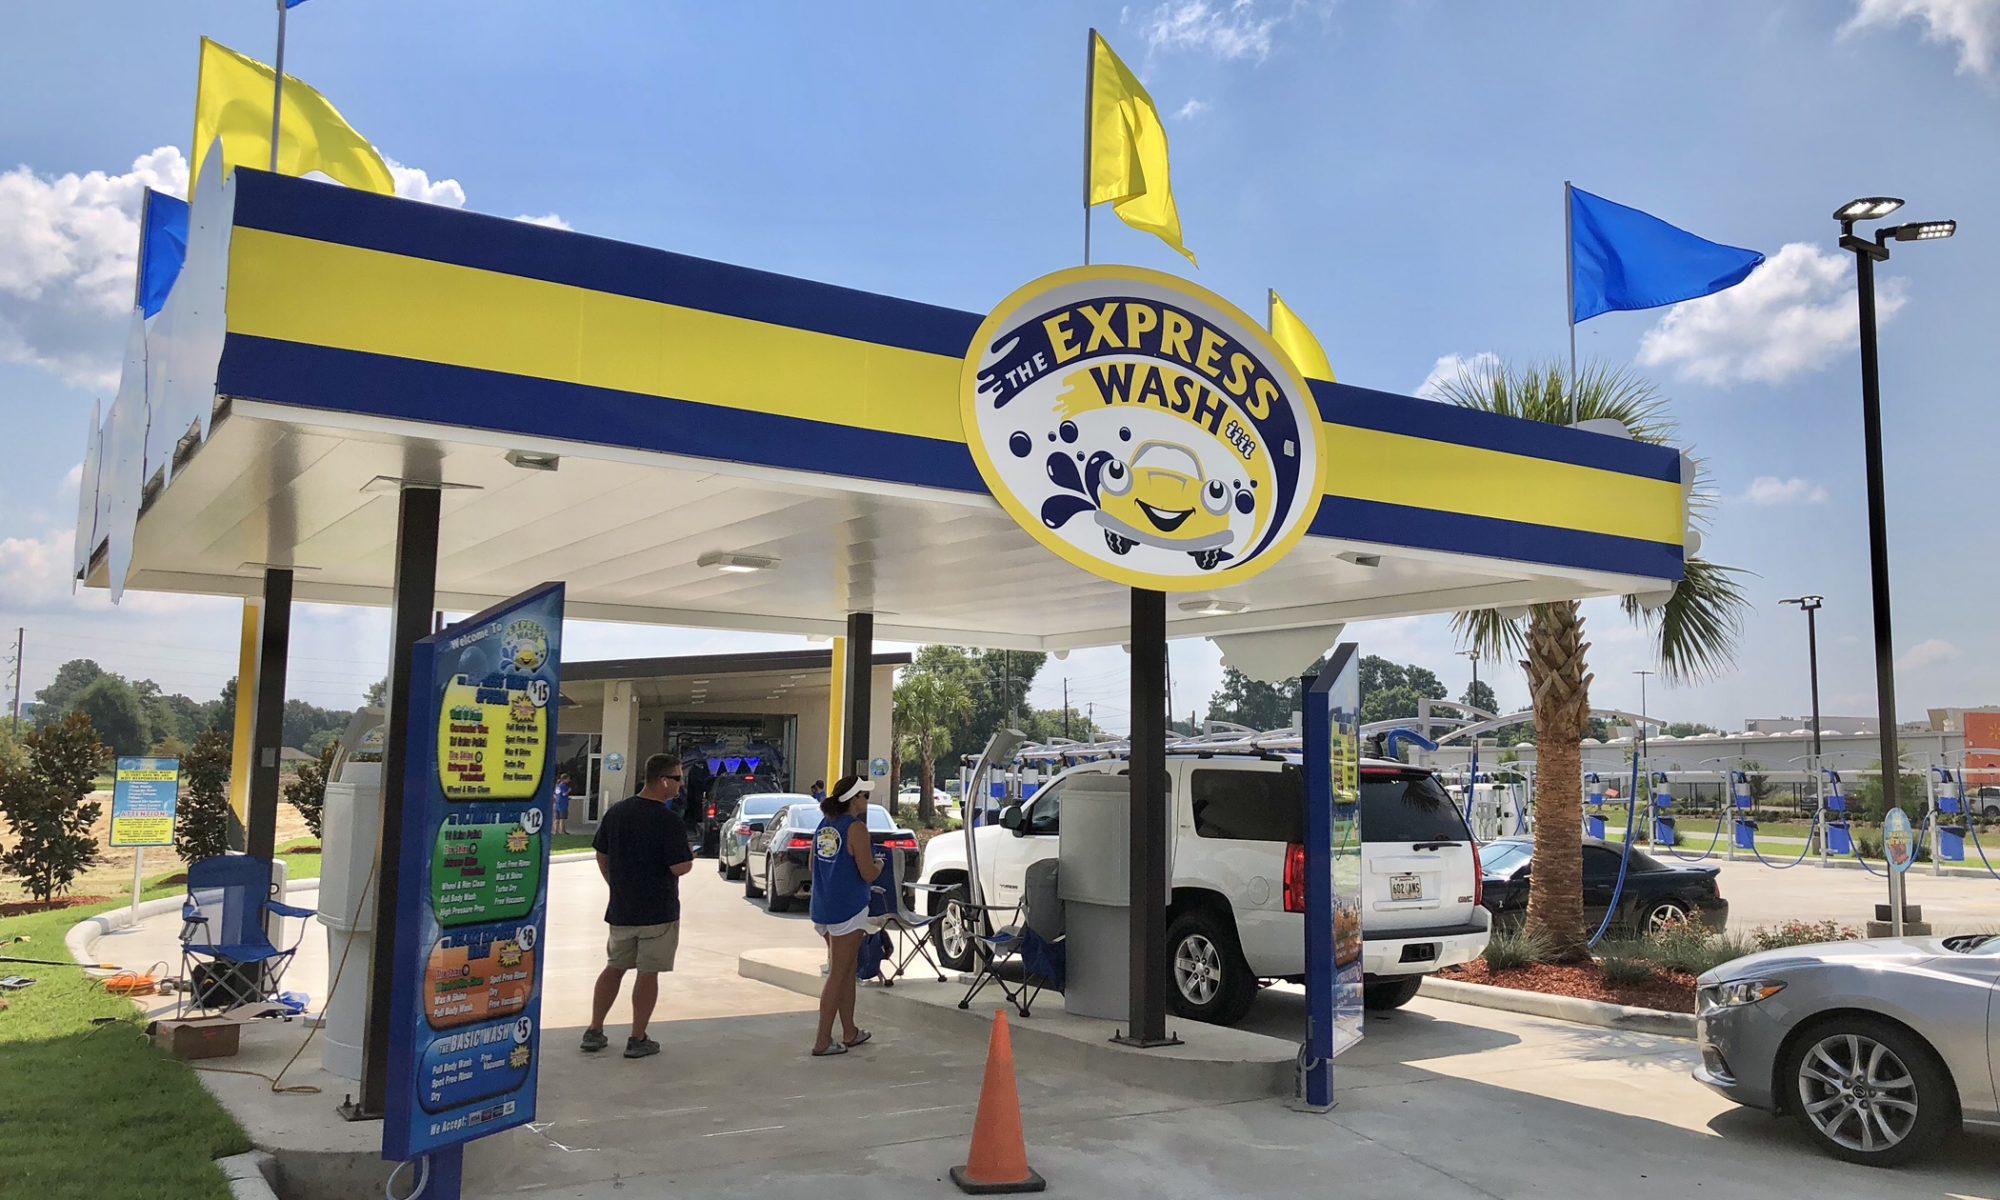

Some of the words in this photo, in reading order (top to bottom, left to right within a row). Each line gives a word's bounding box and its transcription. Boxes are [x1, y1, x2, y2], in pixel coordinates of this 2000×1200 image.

[1005, 351, 1048, 390] THE
[1043, 302, 1279, 421] EXPRESS
[1089, 363, 1228, 435] WASH
[450, 629, 489, 650] Welcome
[491, 622, 503, 634] To
[527, 811, 540, 828] $12
[523, 929, 534, 946] $8
[450, 1029, 480, 1053] BASIC
[482, 1023, 512, 1044] WASH
[518, 1020, 528, 1039] $5
[432, 1065, 443, 1075] Full
[443, 1062, 457, 1072] Body
[432, 1078, 444, 1089] Spot
[445, 1075, 457, 1084] Free
[431, 1092, 441, 1102] Dry
[431, 1122, 440, 1136] We
[442, 1116, 467, 1133] Accept:
